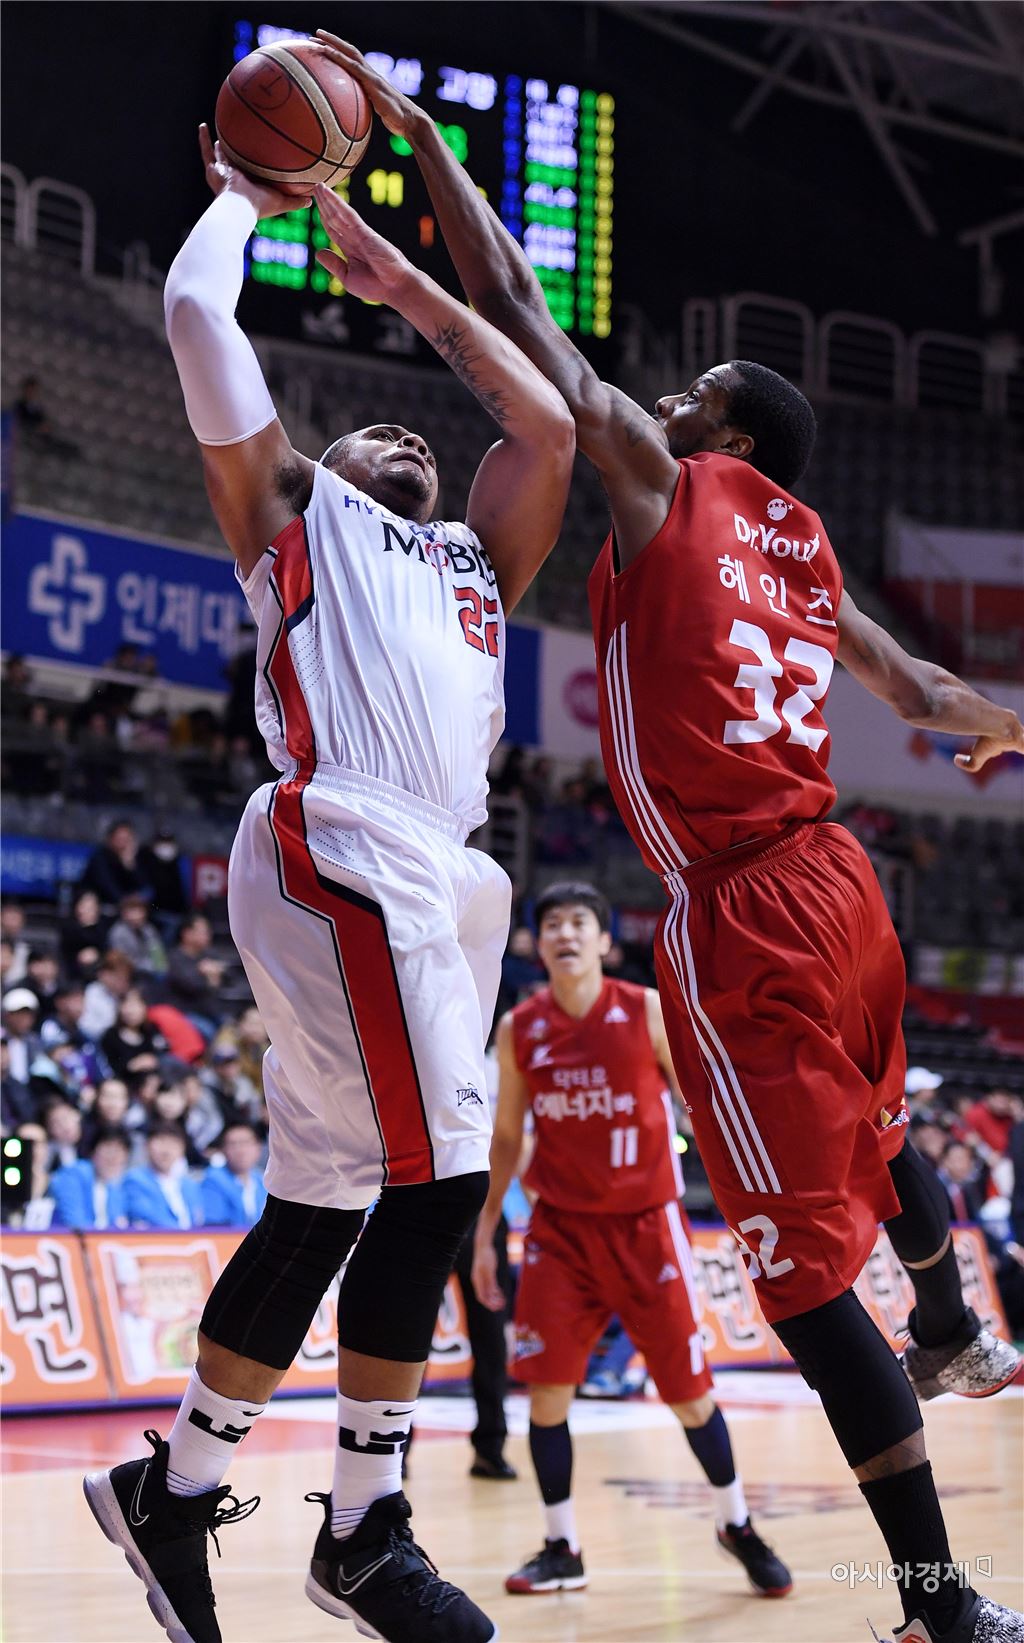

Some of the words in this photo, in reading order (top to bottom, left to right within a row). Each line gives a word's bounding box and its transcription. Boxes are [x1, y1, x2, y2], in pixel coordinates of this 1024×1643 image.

[115, 571, 253, 661] 인제대
[723, 619, 834, 752] 32
[611, 1126, 639, 1168] 11
[0, 1250, 87, 1372] 면
